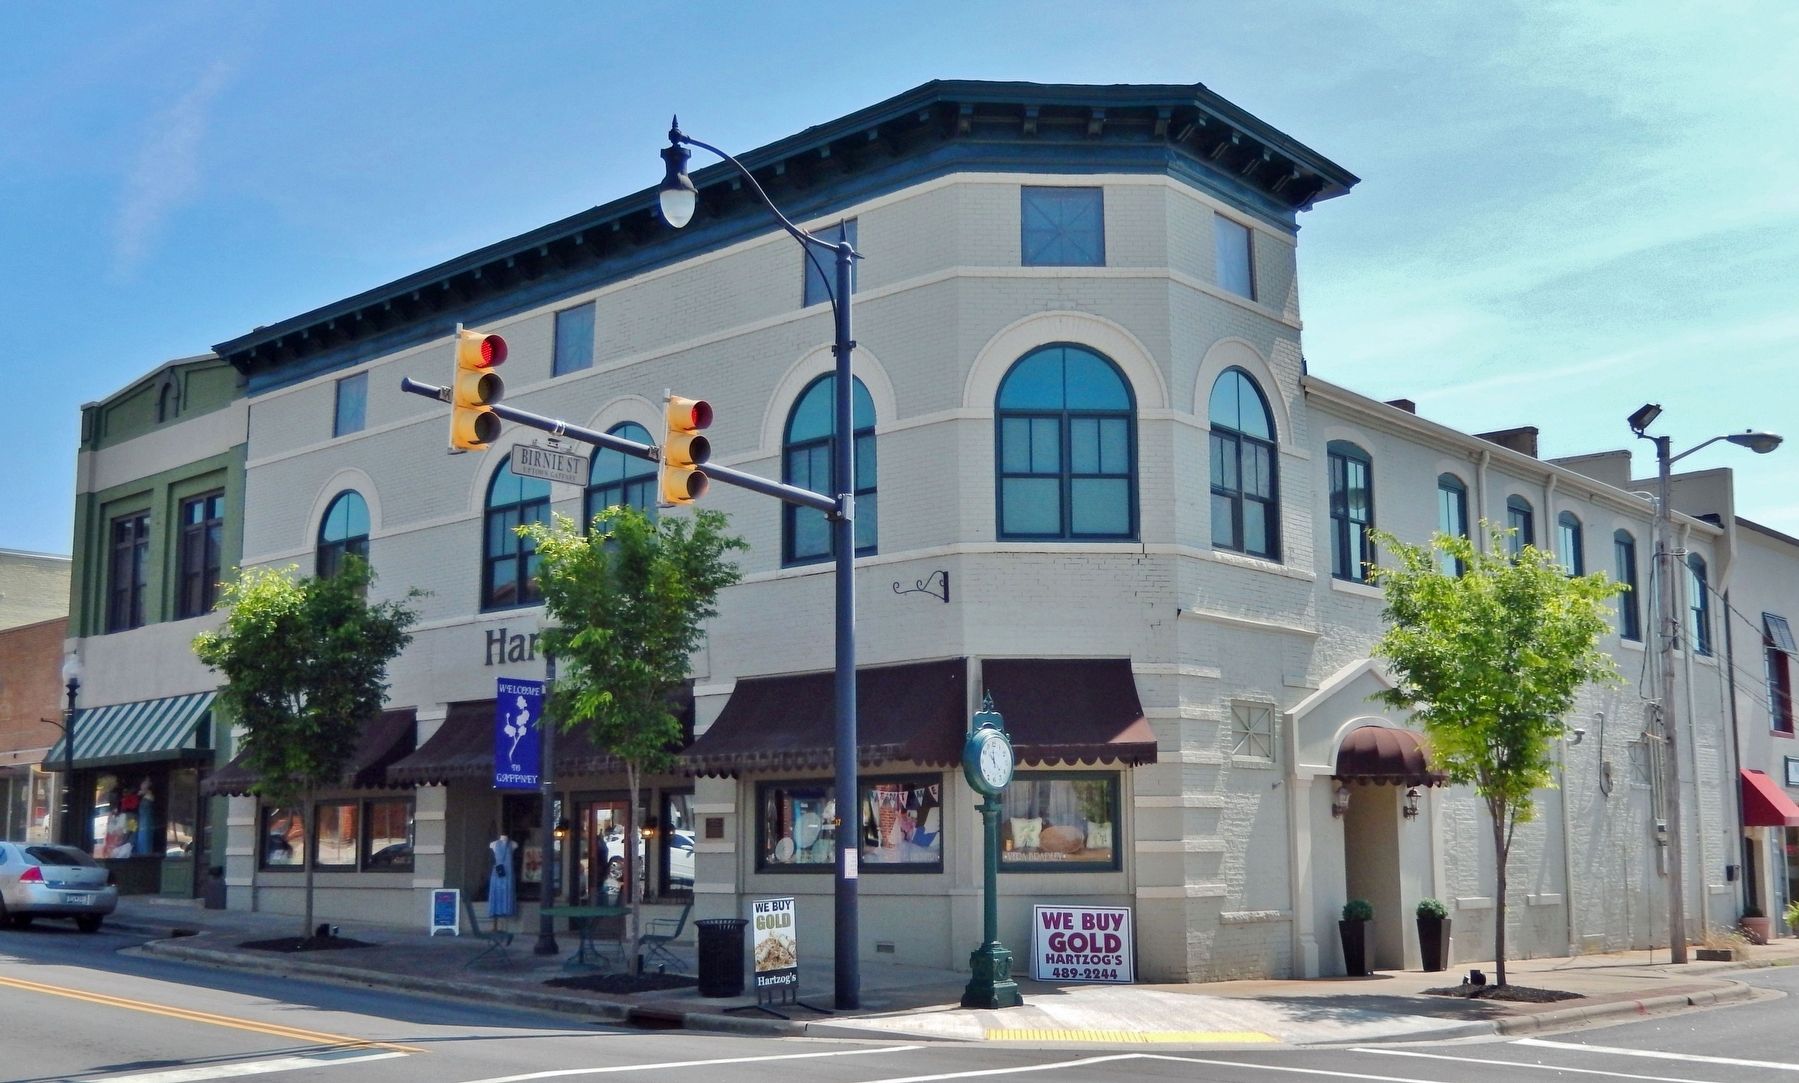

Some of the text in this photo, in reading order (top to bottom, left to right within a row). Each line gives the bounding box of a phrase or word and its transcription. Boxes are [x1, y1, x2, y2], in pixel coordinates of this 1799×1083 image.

[521, 448, 580, 474] BIRNIE ST
[499, 684, 540, 696] WELCOME
[511, 763, 521, 772] TO
[755, 900, 791, 913] WE BUY
[756, 913, 791, 931] GOLD
[1041, 911, 1124, 931] WE BUY
[1048, 931, 1122, 954] GOLD
[1045, 953, 1123, 966] HARTZOG'S
[757, 972, 797, 987] Hartzog's
[1052, 967, 1118, 980] 489-2244
